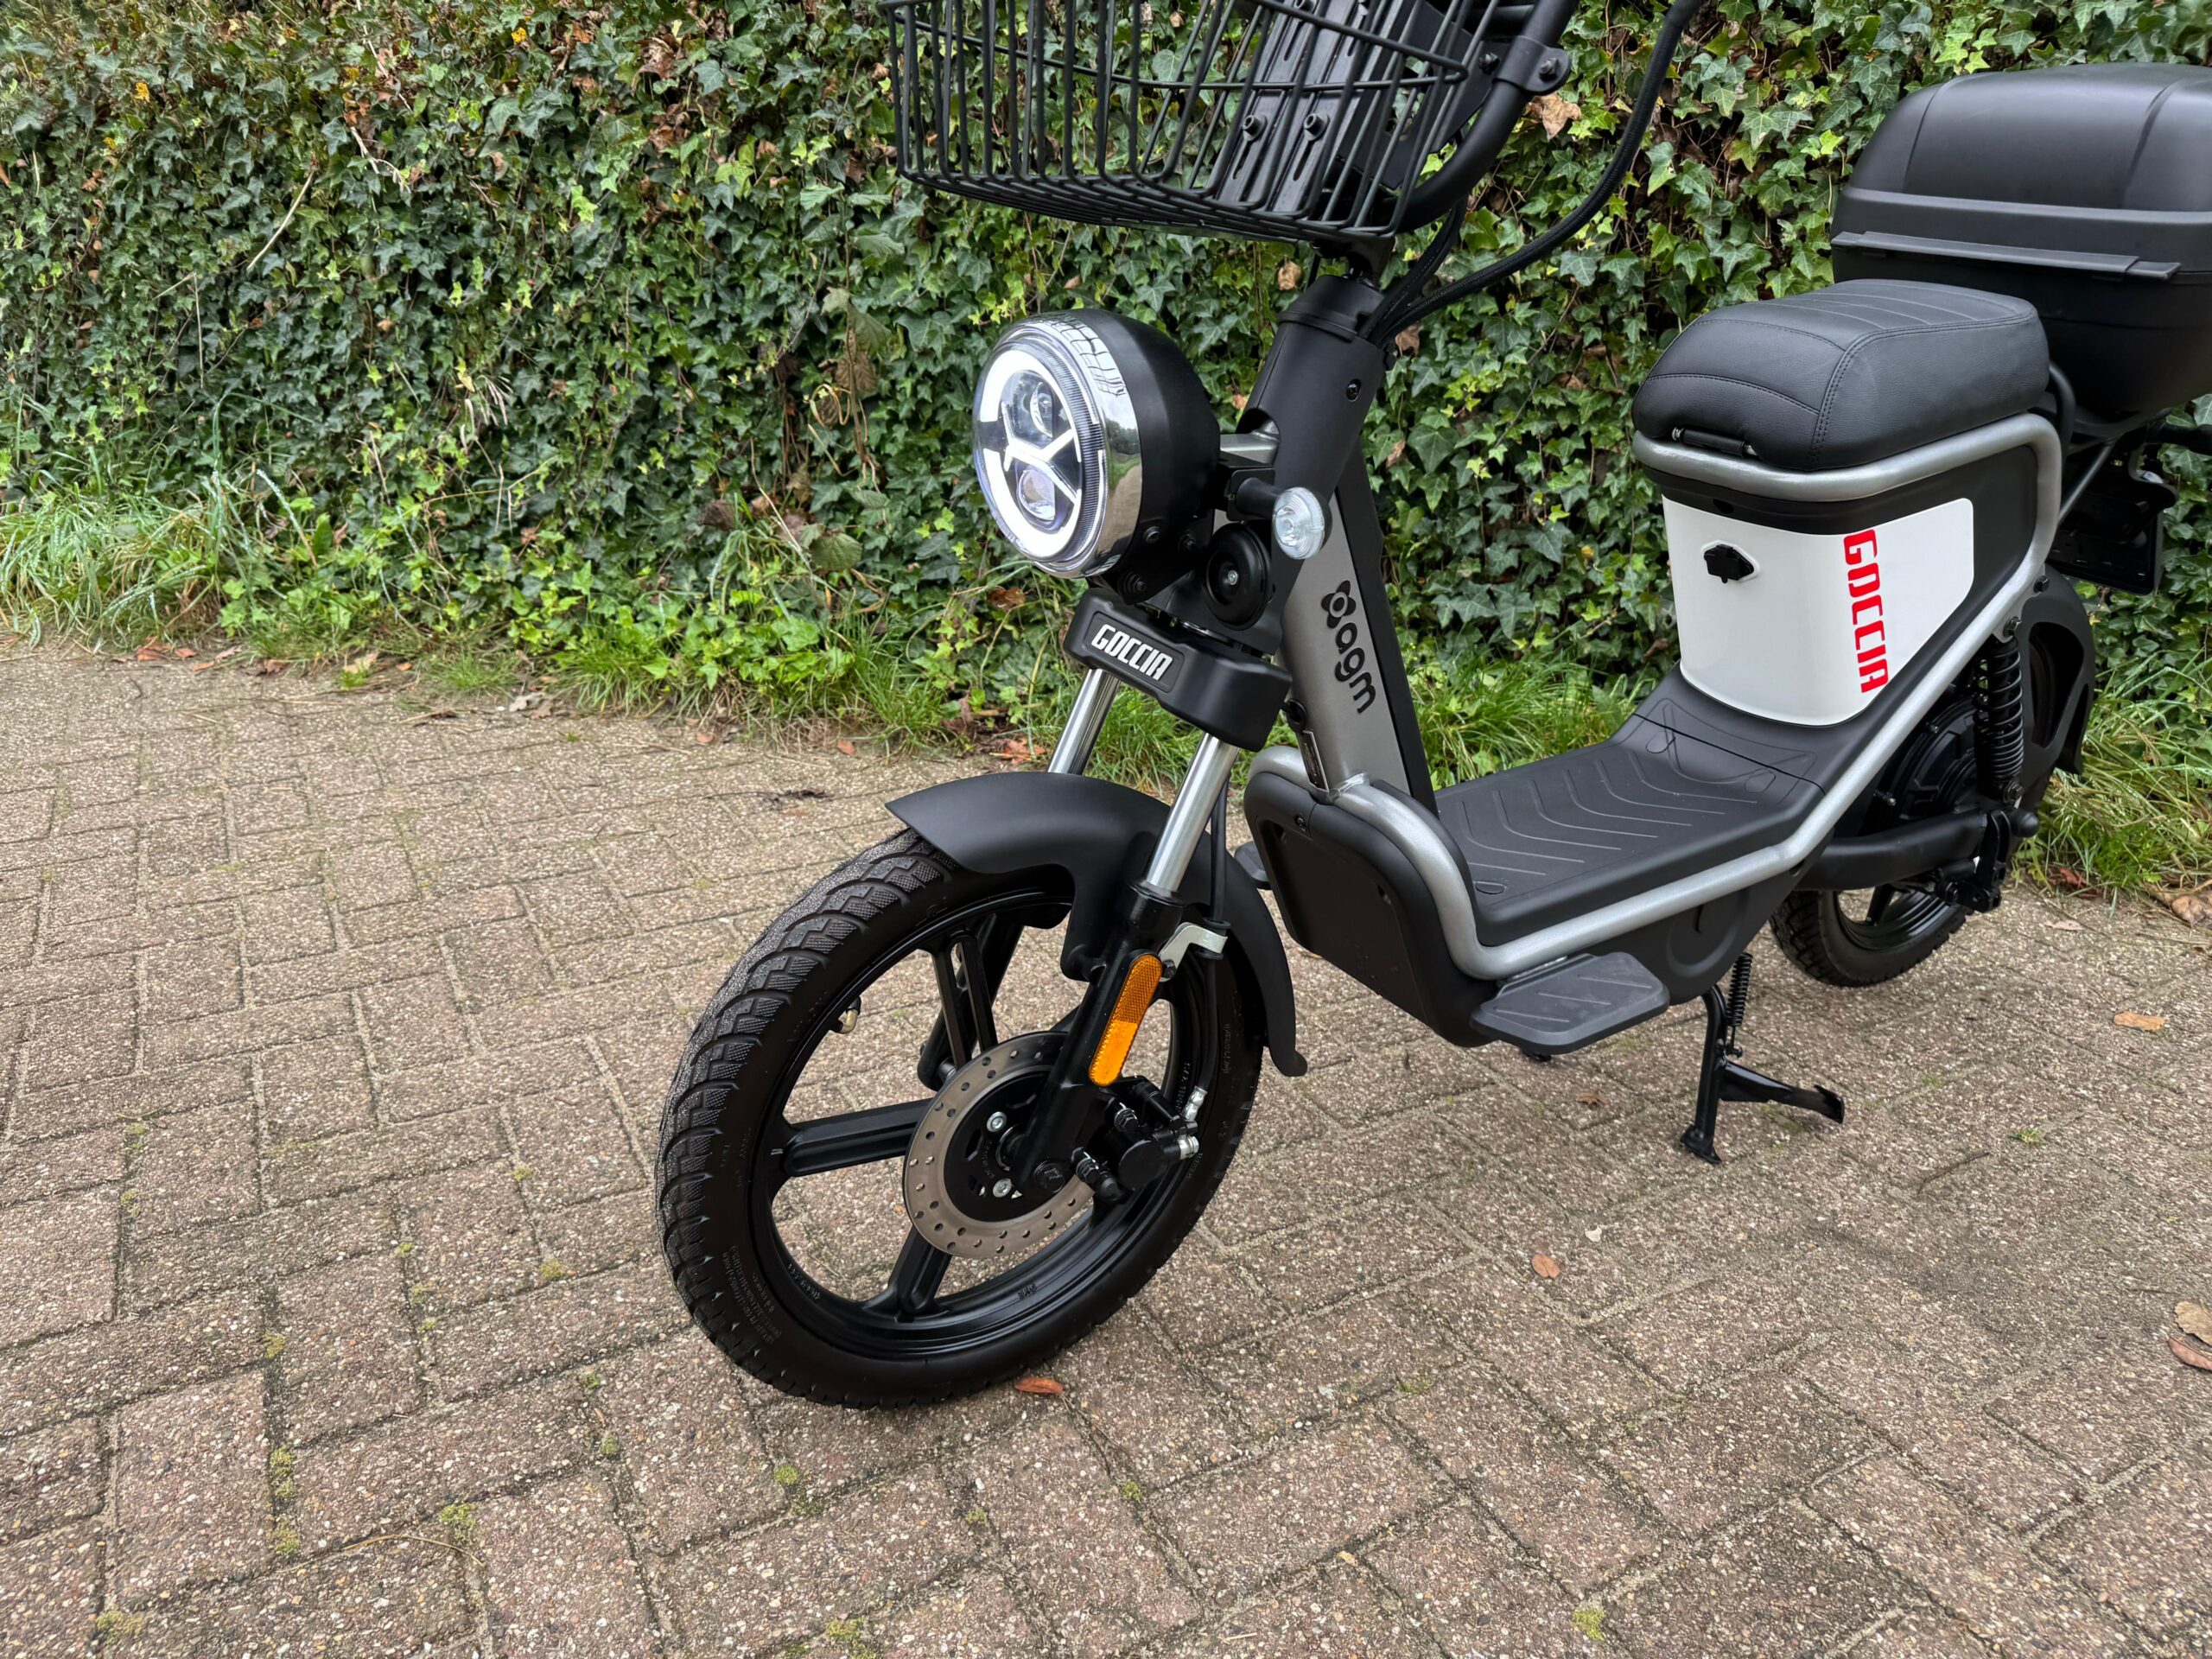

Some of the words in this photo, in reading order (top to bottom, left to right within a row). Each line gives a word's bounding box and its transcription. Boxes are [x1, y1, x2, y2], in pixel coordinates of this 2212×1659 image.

[1090, 623, 1173, 681] GOCCIA
[1843, 529, 1889, 694] GOCCIA
[1334, 622, 1376, 715] agm
